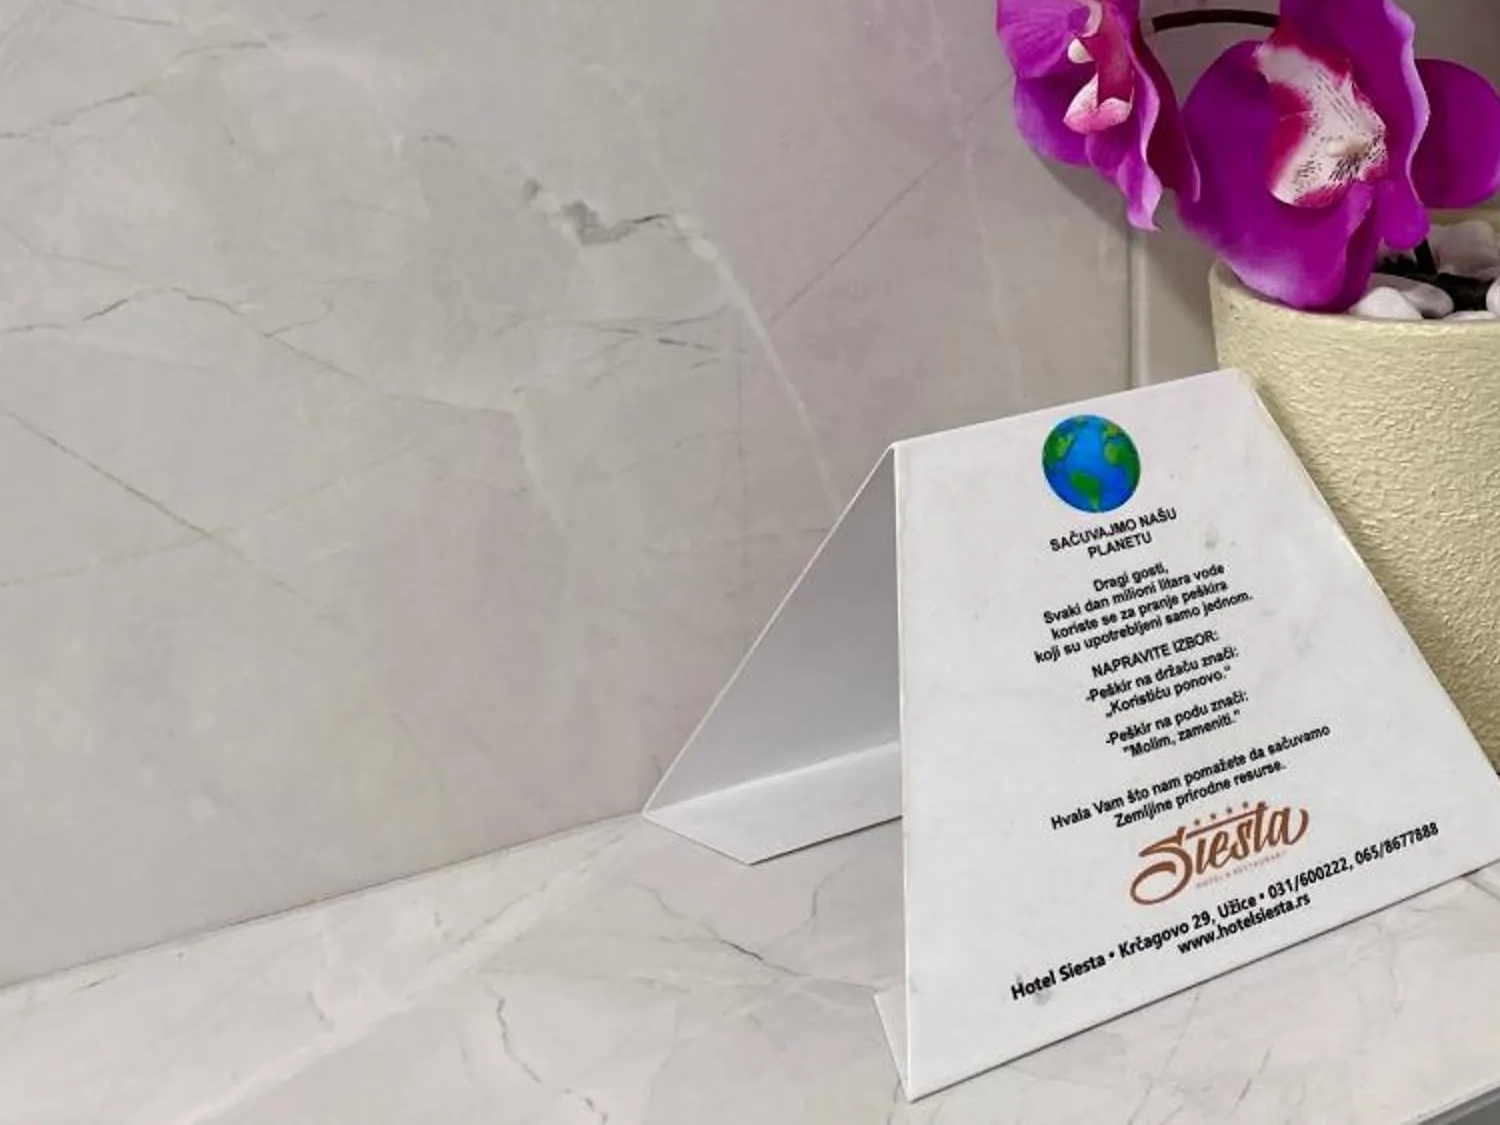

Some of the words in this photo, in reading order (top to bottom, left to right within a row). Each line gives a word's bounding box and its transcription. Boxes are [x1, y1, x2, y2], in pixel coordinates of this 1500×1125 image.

[1050, 518, 1136, 552] SAČUVAJMO
[1139, 507, 1178, 529] NAŠU
[1087, 531, 1152, 558] PLANETU
[1043, 602, 1082, 624] Svaki
[1084, 596, 1110, 612] dan
[1112, 582, 1156, 604] milioni
[1159, 573, 1192, 592] litara
[1194, 563, 1225, 581] vode
[1093, 572, 1129, 592] Dragi
[1132, 562, 1169, 583] gosti,
[1034, 645, 1061, 665] koji
[1064, 641, 1081, 654] su
[1084, 615, 1163, 650] upotrebljeni
[1165, 607, 1200, 625] samo
[1203, 591, 1254, 616] jednom.
[1051, 617, 1099, 640] koriste
[1101, 613, 1118, 626] se
[1120, 608, 1136, 620] za
[1138, 596, 1179, 618] pranje
[1181, 581, 1228, 604] peškira
[1091, 643, 1171, 678] NAPRAVITE
[1172, 629, 1220, 654] IZBOR:
[1135, 675, 1153, 688] na
[1155, 660, 1199, 682] držaču
[1201, 646, 1239, 668] znači:
[1155, 717, 1173, 730] na
[1174, 704, 1209, 726] podu
[1210, 690, 1249, 711] znači:
[1050, 807, 1092, 830] Hvala
[1092, 795, 1125, 815] Vam
[1126, 786, 1150, 805] što
[1152, 778, 1181, 796] nam
[1183, 753, 1247, 787] pomažete
[1248, 747, 1266, 762] da
[1267, 725, 1332, 756] sačuvamo
[1113, 799, 1173, 828] Zemljine
[1175, 778, 1231, 810] prirodne
[1233, 759, 1287, 785] resurse.
[1129, 801, 1310, 905] Siesta
[1011, 970, 1057, 1000] Hotel
[1059, 953, 1107, 983] Siesta
[1118, 921, 1189, 959] Krčagovo
[1191, 910, 1216, 930] 29,
[1217, 893, 1257, 919] Užice
[1267, 856, 1353, 900] 031/600222,
[1355, 822, 1439, 864] 065/8677888
[1177, 893, 1311, 954] www.hotelsiesta.rs
